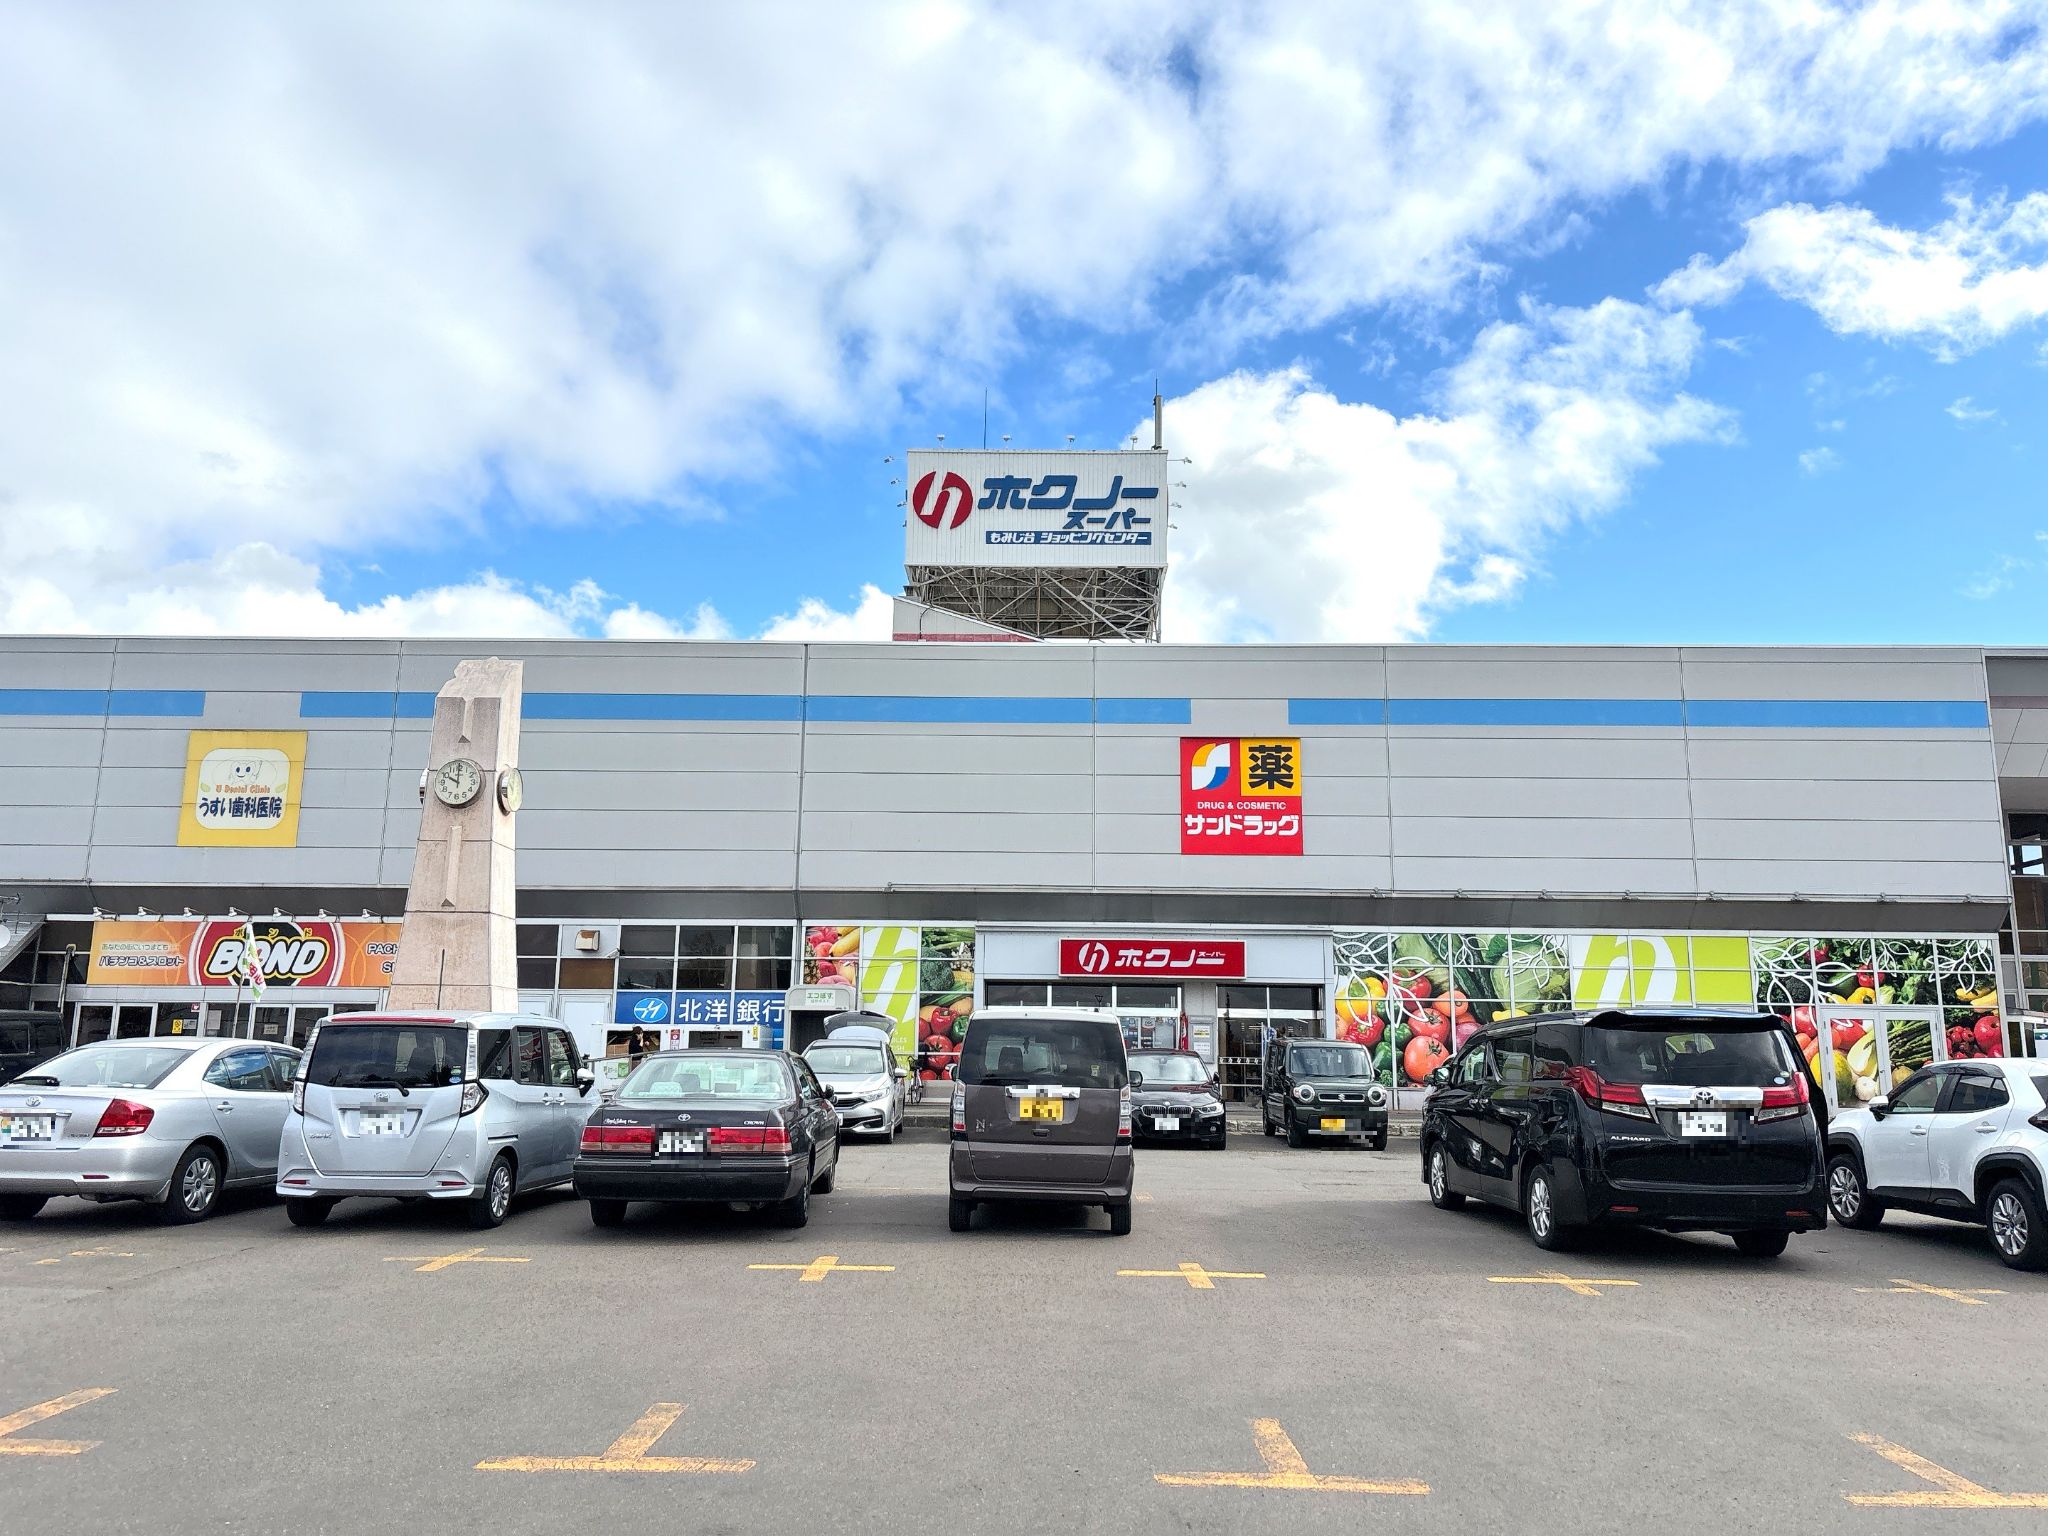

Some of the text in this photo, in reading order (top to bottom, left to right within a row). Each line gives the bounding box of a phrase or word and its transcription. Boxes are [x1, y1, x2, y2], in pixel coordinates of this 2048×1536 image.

[978, 475, 1159, 510] ホクノー
[1062, 507, 1152, 530] スーパー
[990, 532, 1148, 544] もみじ台 ショッピングセンター
[1248, 744, 1294, 790] 薬
[199, 797, 282, 818] うすい歯科医院
[1197, 801, 1286, 810] DRUG & COSMETIC
[1184, 813, 1300, 836] サンドラッグ
[207, 939, 328, 976] BOND
[1115, 948, 1225, 968] ホクノー
[678, 998, 785, 1022] 北洋銀行
